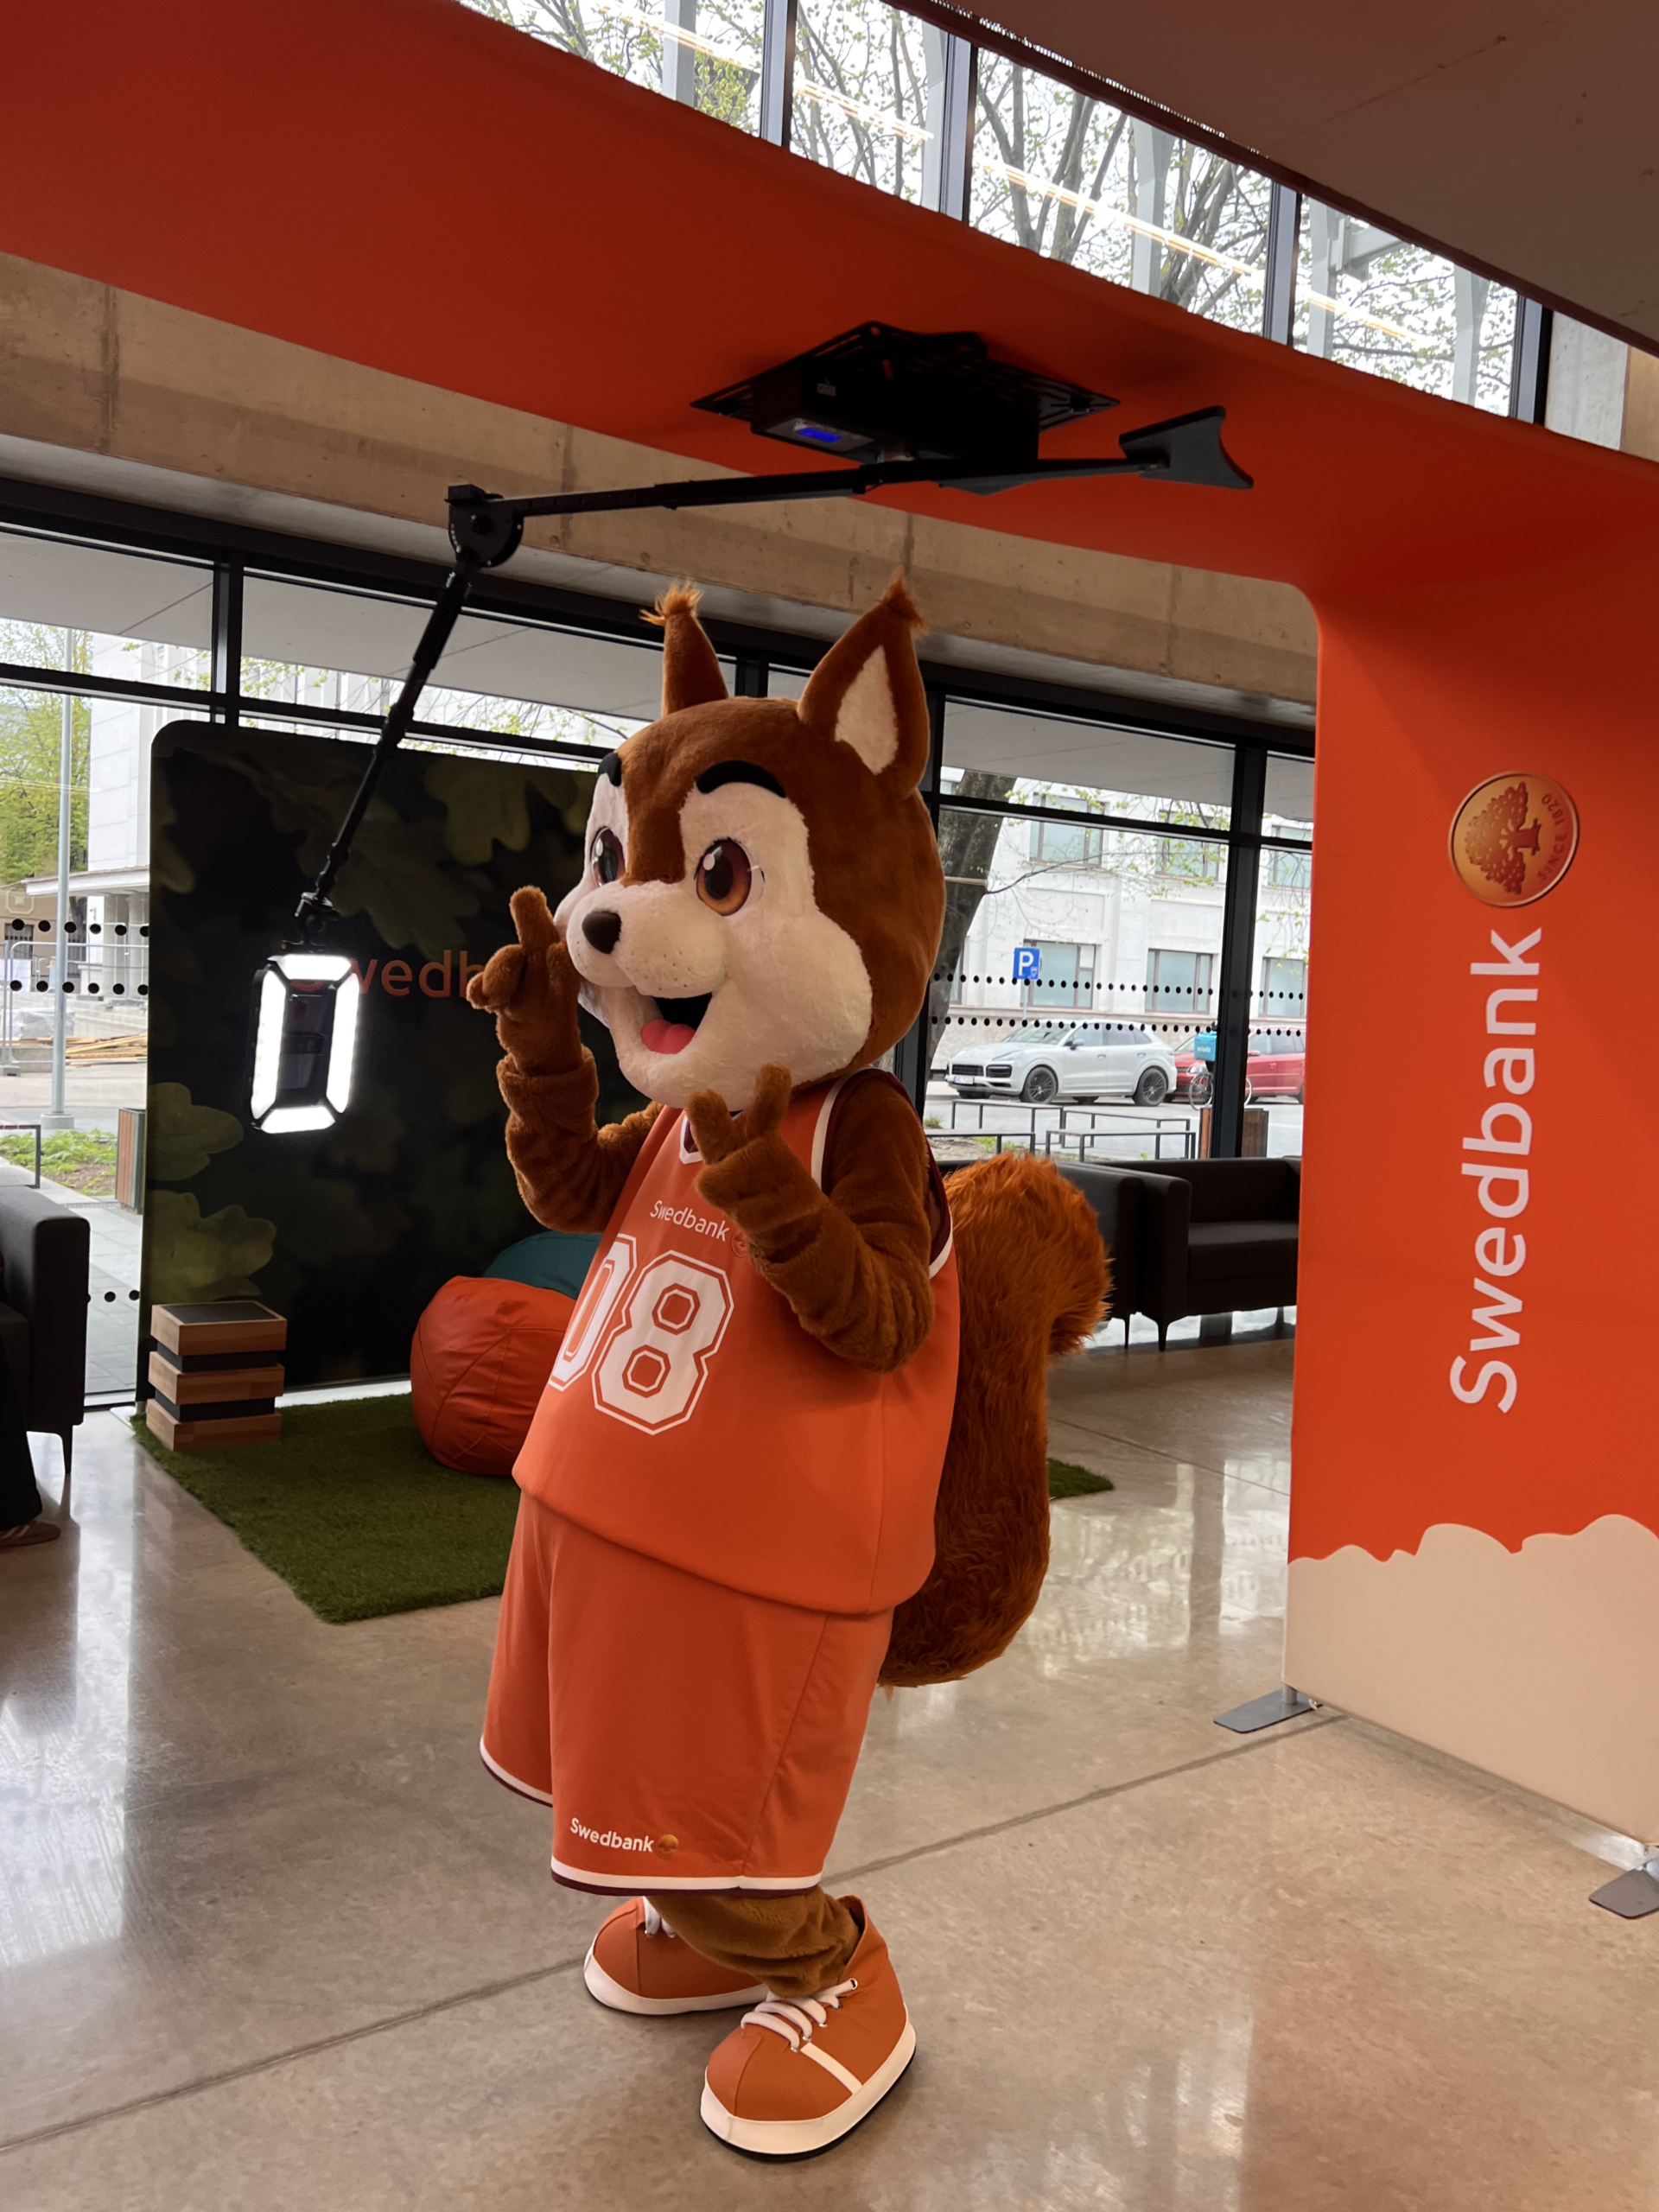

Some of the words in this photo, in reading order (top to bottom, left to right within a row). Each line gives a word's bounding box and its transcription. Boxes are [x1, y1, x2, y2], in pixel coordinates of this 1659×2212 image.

[1541, 792, 1566, 825] 1820
[1537, 833, 1567, 882] SINCE
[1018, 950, 1034, 976] P
[1449, 926, 1542, 1414] Swedbank
[650, 1199, 730, 1242] Swedbank
[569, 1817, 655, 1853] Swedbank
